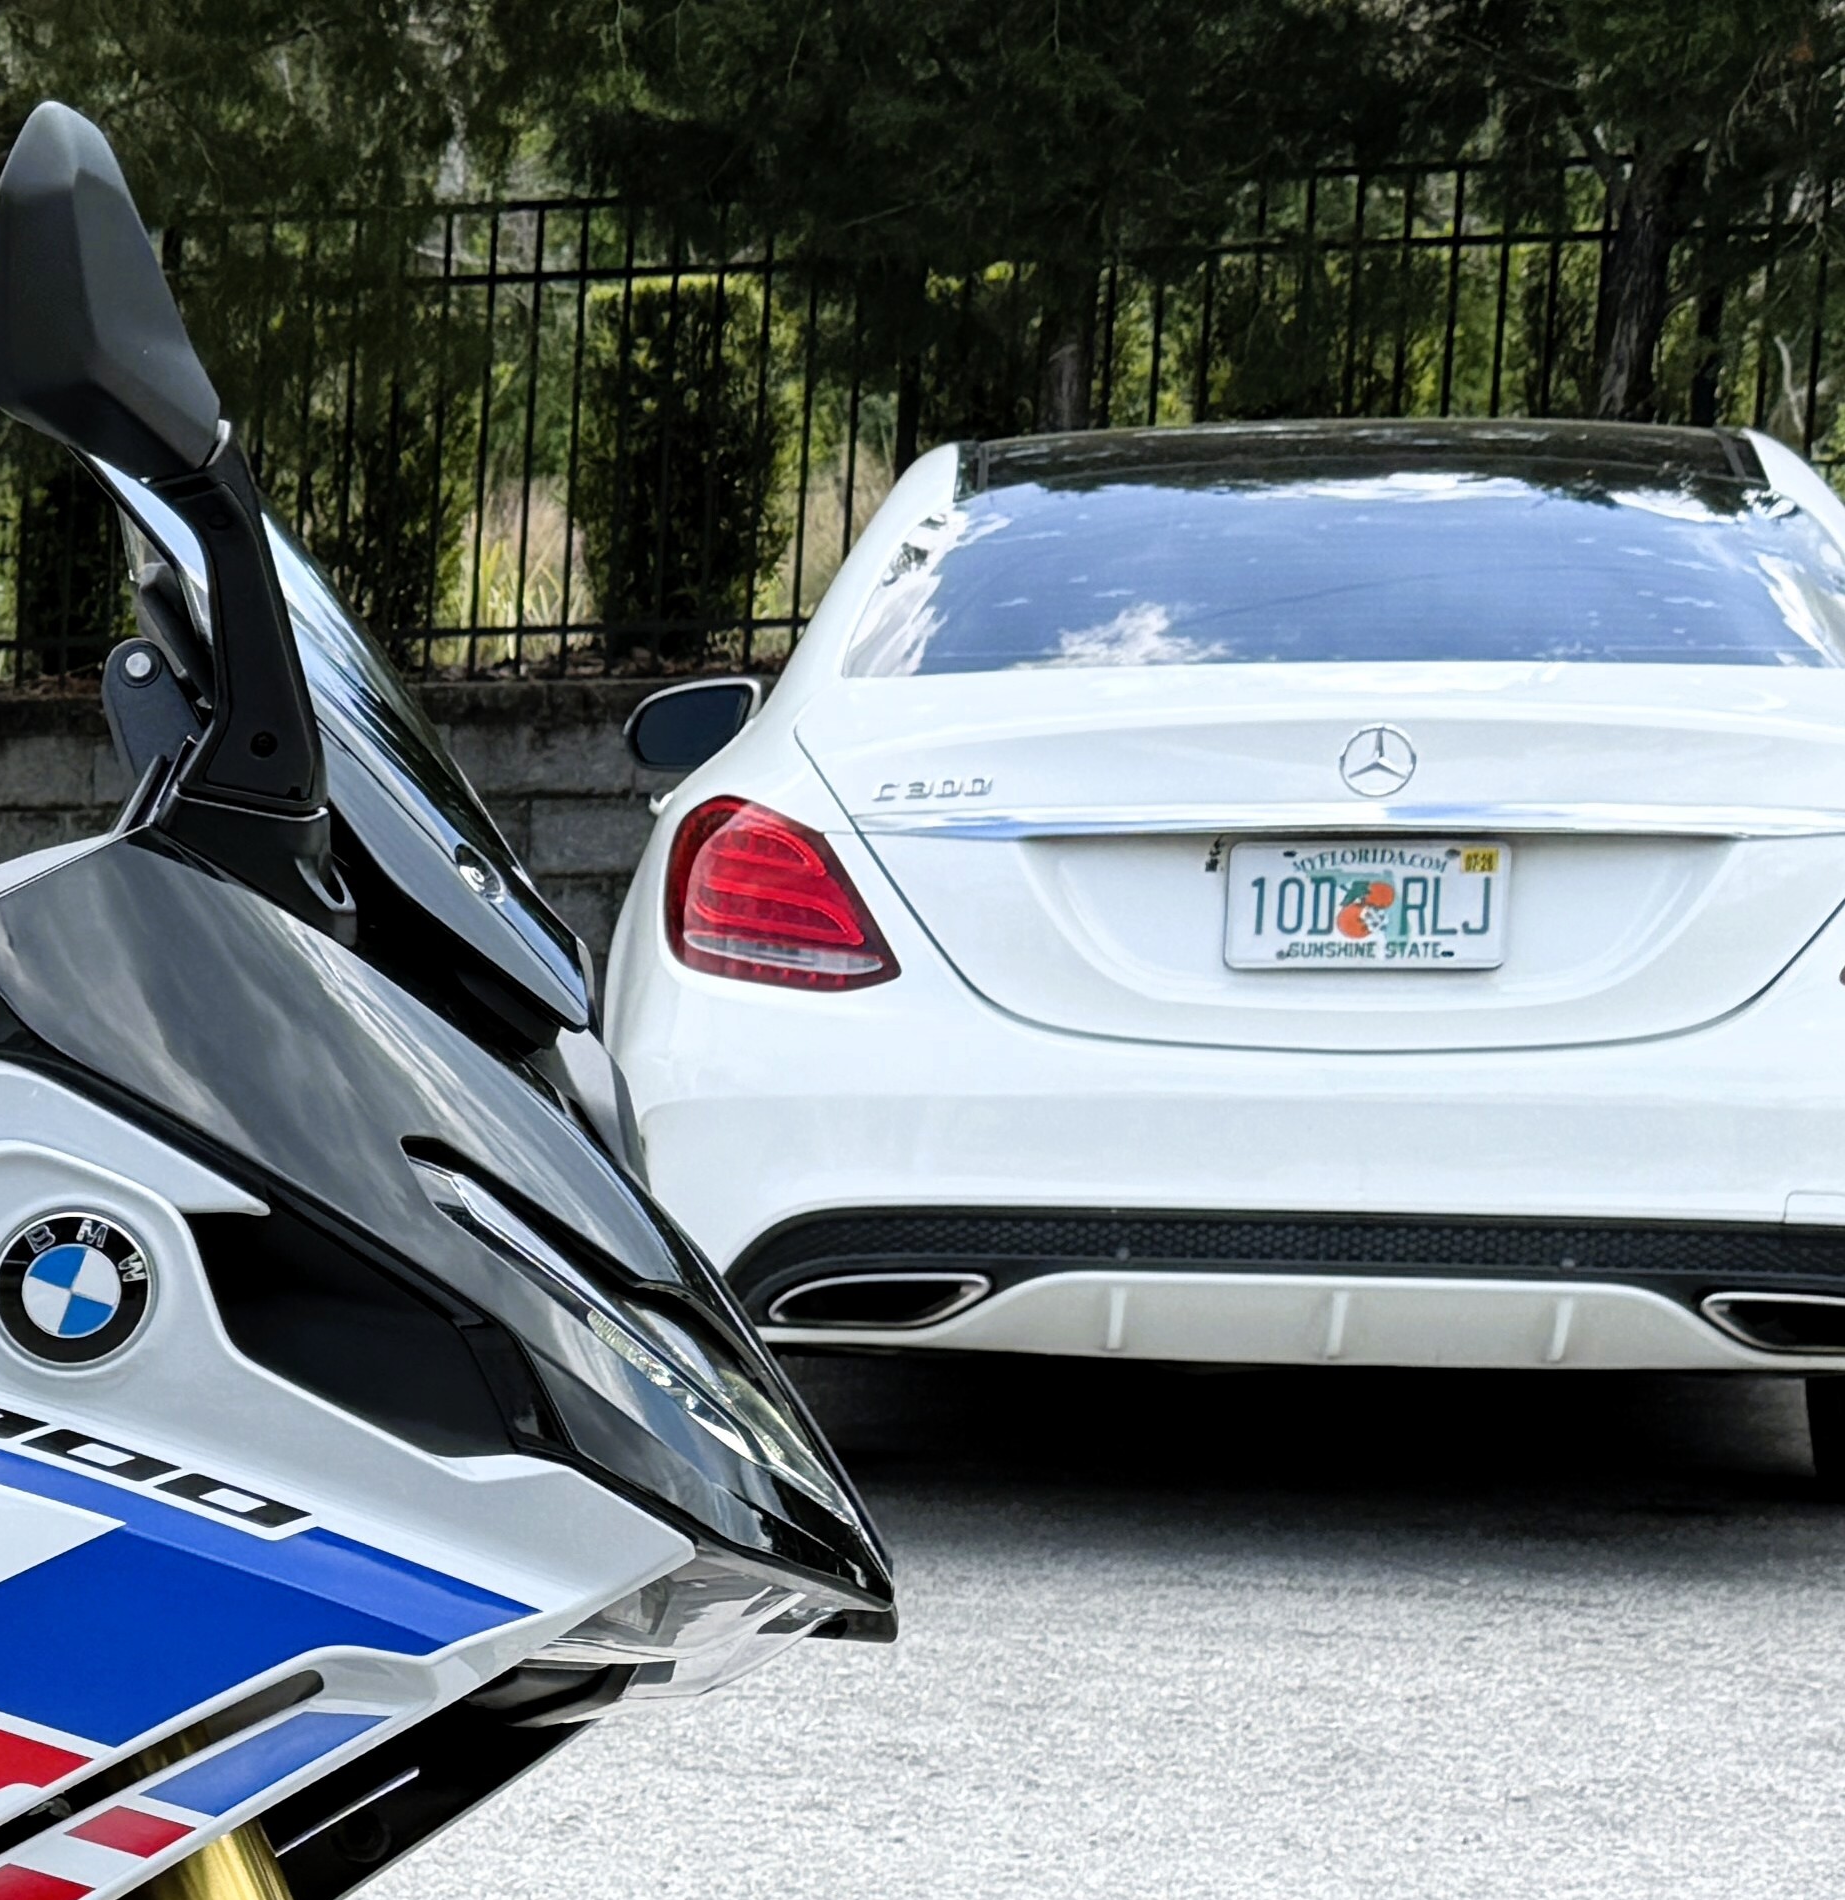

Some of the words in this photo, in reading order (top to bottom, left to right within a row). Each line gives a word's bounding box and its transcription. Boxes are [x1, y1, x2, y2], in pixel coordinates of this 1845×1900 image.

[1292, 848, 1447, 873] MYFLORIDA.COM
[1399, 876, 1491, 936] RLJ
[1288, 941, 1376, 960] SUNSHINE
[1385, 941, 1442, 960] STATE
[24, 1218, 147, 1283] BMW
